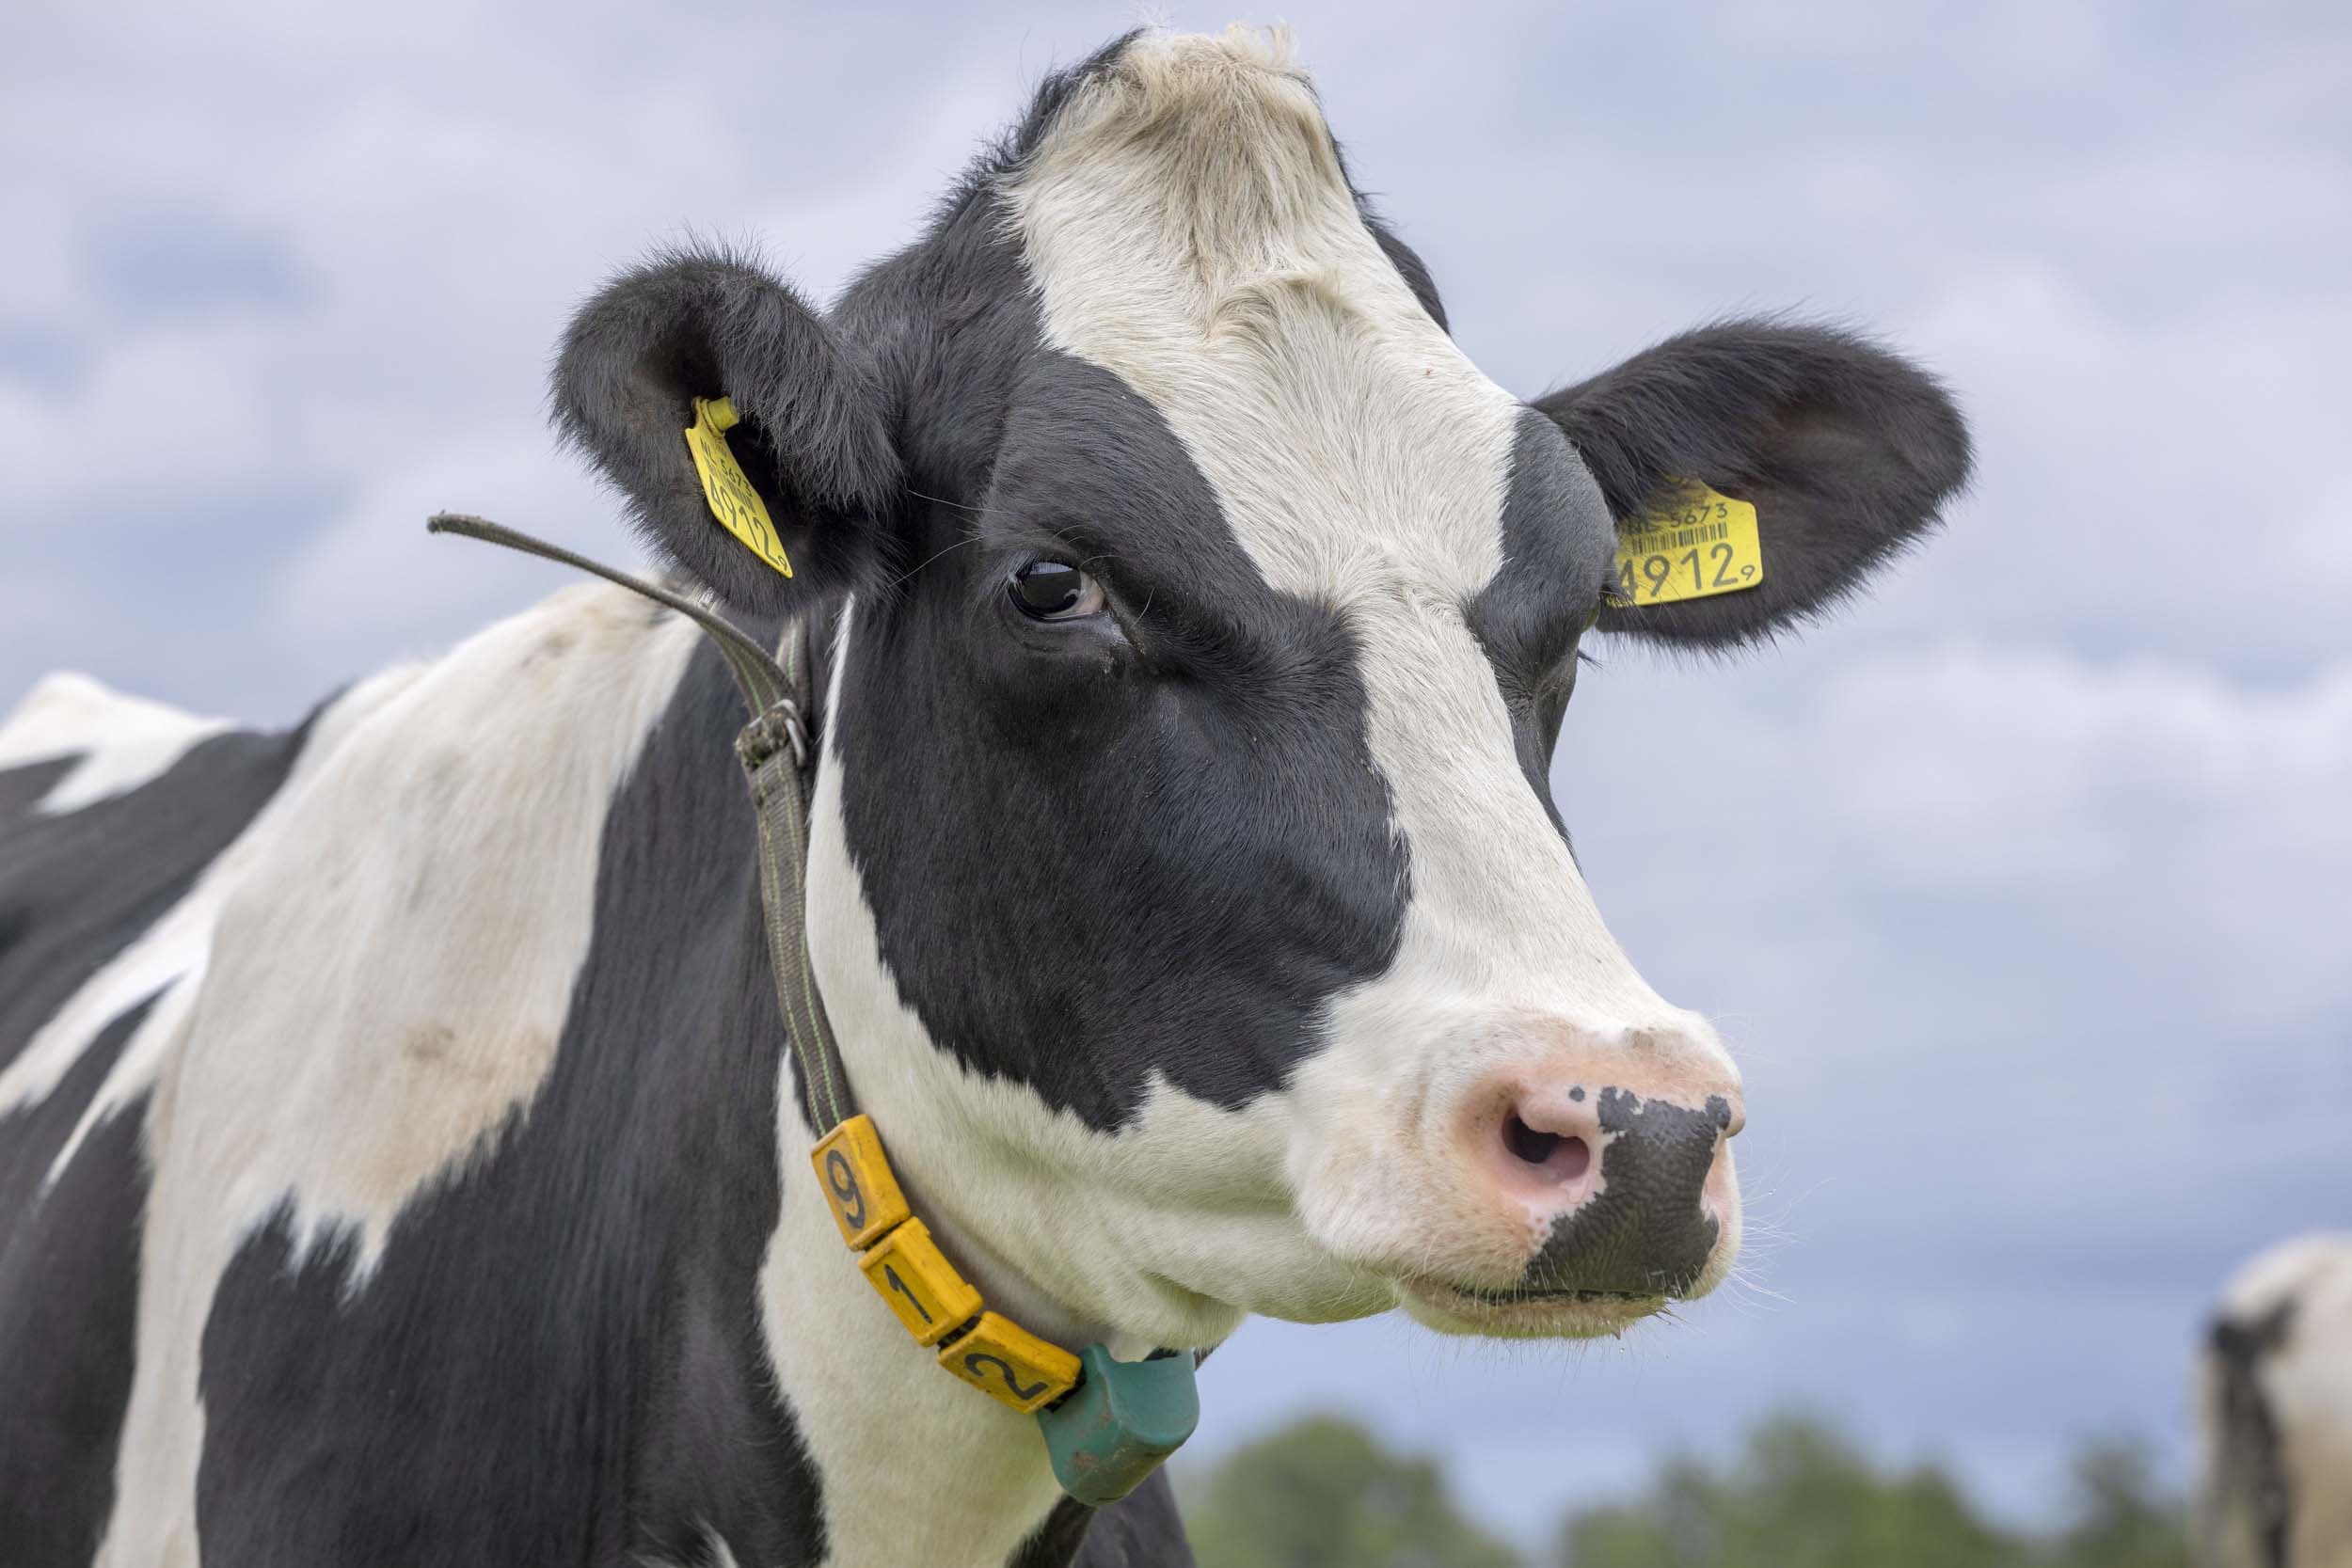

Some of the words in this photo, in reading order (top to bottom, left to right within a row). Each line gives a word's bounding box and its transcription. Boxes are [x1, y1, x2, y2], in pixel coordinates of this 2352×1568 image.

[720, 458, 753, 498] 5673
[708, 474, 779, 565] 4912
[1670, 502, 1728, 528] 5673
[1619, 542, 1739, 599] 4912
[1740, 564, 1756, 581] 9
